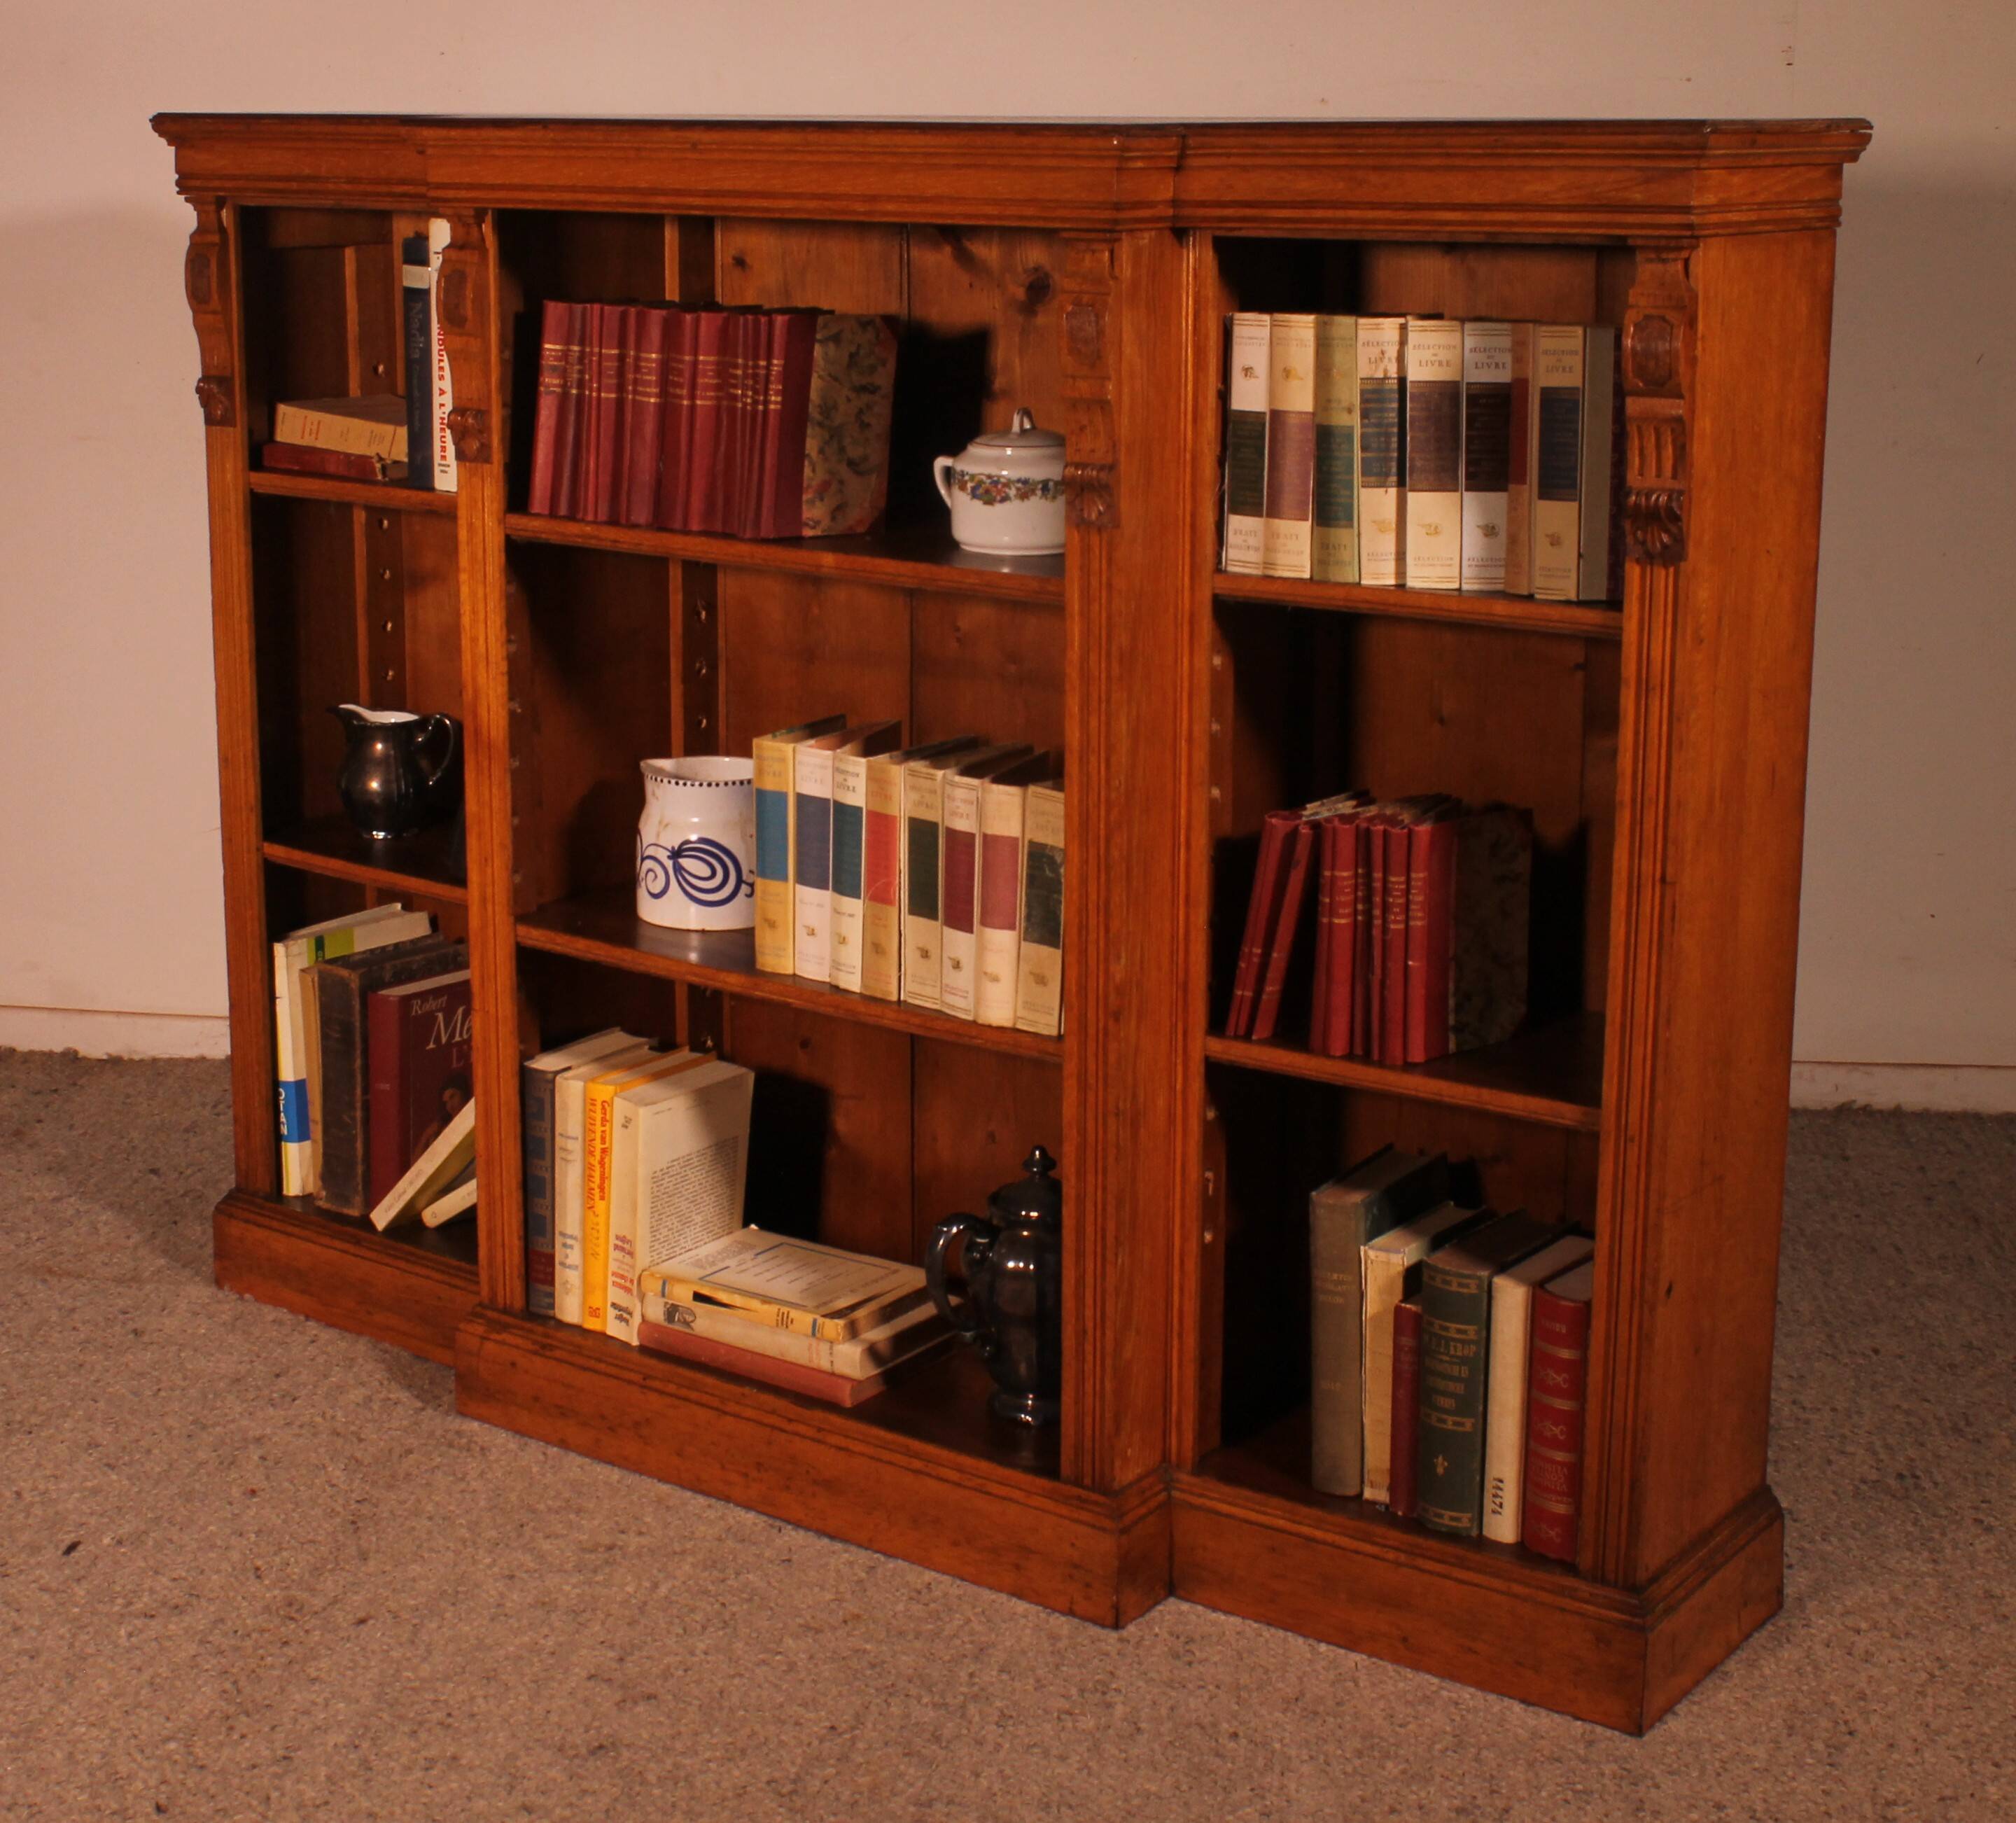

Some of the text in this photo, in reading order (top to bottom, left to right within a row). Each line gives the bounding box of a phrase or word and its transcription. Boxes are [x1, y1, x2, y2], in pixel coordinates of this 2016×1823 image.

[1418, 358, 1452, 368] LIVRE
[1474, 361, 1508, 370] LIVRE
[439, 387, 446, 396] À
[439, 403, 447, 461] L'HEURE
[410, 993, 448, 1017] Robert
[426, 1005, 472, 1050] Me
[598, 1100, 610, 1200] Gerda van Wageningen
